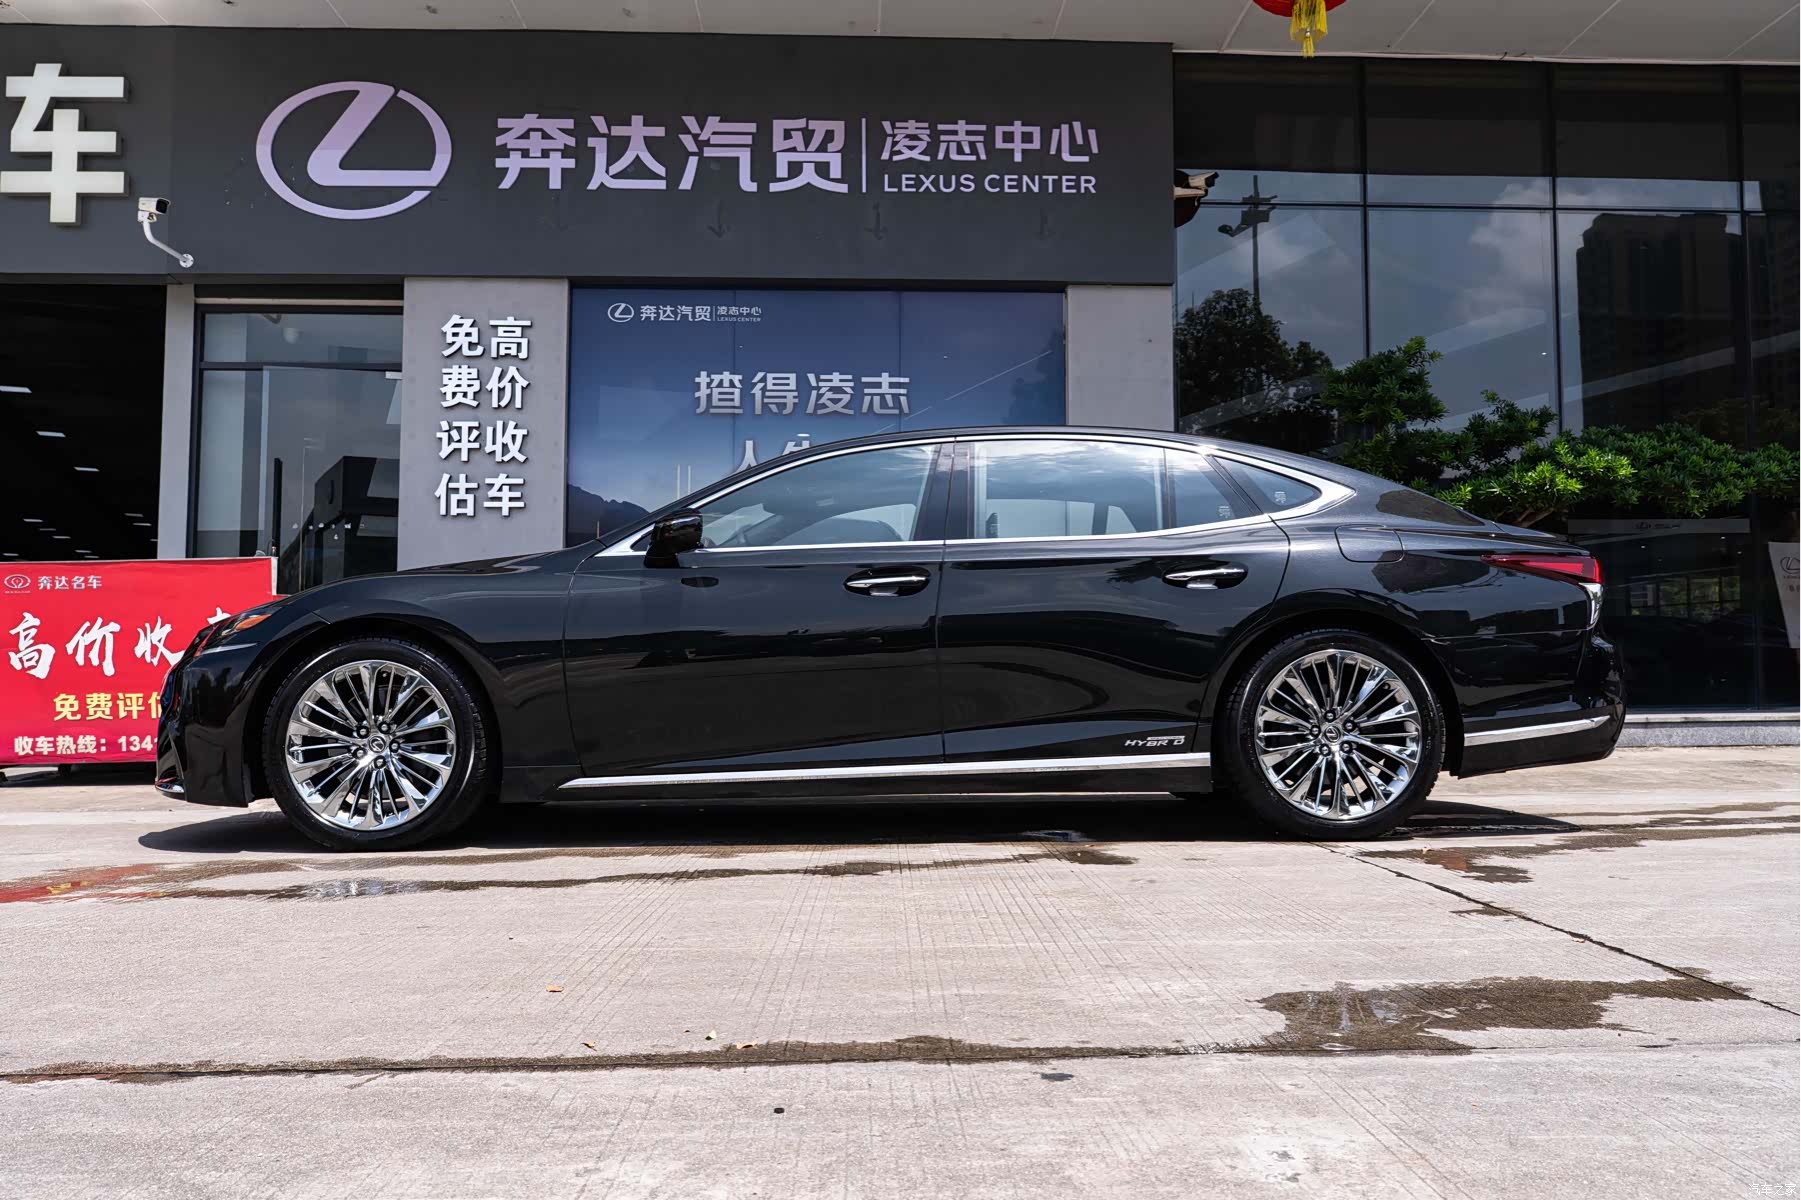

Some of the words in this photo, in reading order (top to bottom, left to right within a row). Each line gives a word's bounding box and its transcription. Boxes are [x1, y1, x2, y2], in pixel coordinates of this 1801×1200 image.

[0, 63, 125, 224] 车
[495, 113, 849, 193] 奔达汽贸
[880, 120, 1099, 162] 凌志中心
[884, 174, 975, 192] LEXUS
[984, 174, 1096, 193] CENTER
[640, 305, 711, 321] 奔达汽贸
[717, 306, 762, 316] 凌志中心
[434, 314, 484, 516] 免费评估
[694, 371, 910, 415] 揸得凌志
[483, 316, 533, 516] 高价收车
[38, 575, 102, 590] 奔达名车
[8, 606, 232, 680] 高价收
